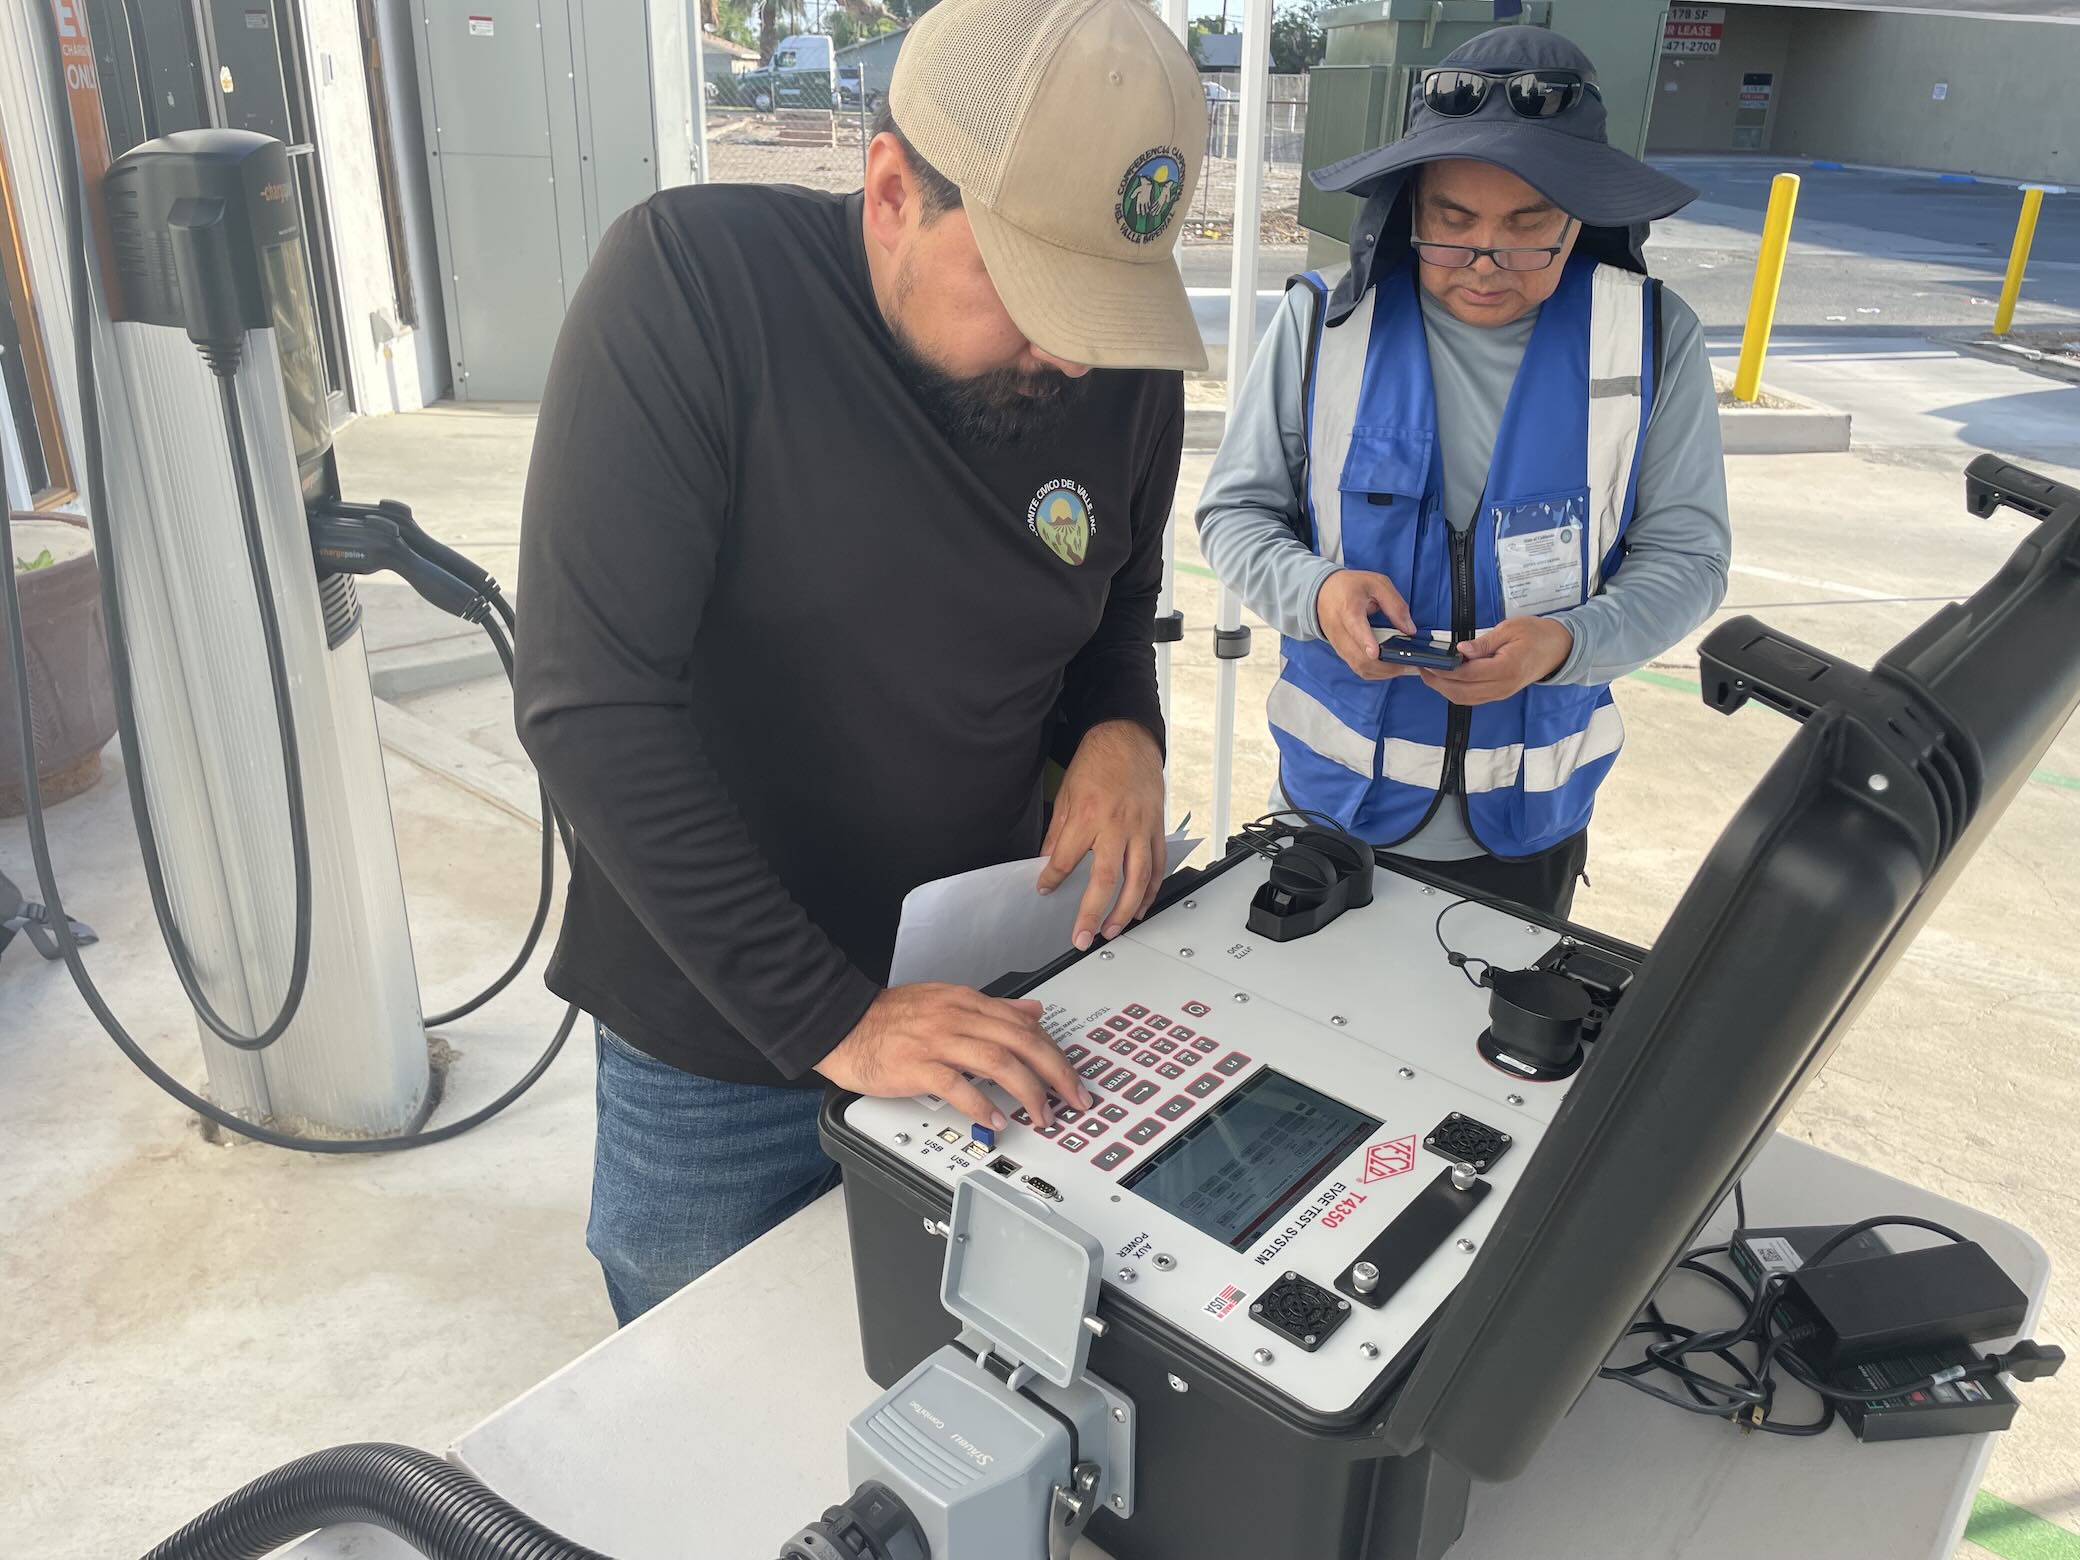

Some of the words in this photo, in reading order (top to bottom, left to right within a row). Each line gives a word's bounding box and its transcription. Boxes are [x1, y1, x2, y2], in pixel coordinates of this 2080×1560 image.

[1695, 9, 1708, 20] SF
[1677, 25, 1712, 37] LEASE
[1117, 145, 1170, 196] CONFERENCIA
[1114, 203, 1122, 224] DEL
[1120, 223, 1141, 244] VALLE
[1061, 478, 1076, 491] DEL
[1227, 943, 1244, 955] DUO
[1086, 1006, 1111, 1022] TESCO
[1066, 1048, 1083, 1061] HEL
[1081, 1059, 1107, 1077] SPACE
[1225, 1059, 1238, 1069] F1
[1104, 1070, 1131, 1089] ENTER
[1198, 1081, 1211, 1090] F2
[1168, 1103, 1182, 1113] F3
[1138, 1126, 1152, 1137] F4
[924, 1139, 944, 1153] USB
[950, 1154, 970, 1168] USB
[1105, 1151, 1119, 1162] F5
[1317, 1181, 1347, 1207] EVSE
[1294, 1205, 1323, 1229] TEST
[1321, 1192, 1368, 1228] T4350
[1115, 1231, 1149, 1258] POWER
[1133, 1242, 1152, 1259] AUX
[1254, 1227, 1298, 1266] SYSTEM
[1204, 1296, 1228, 1314] USA
